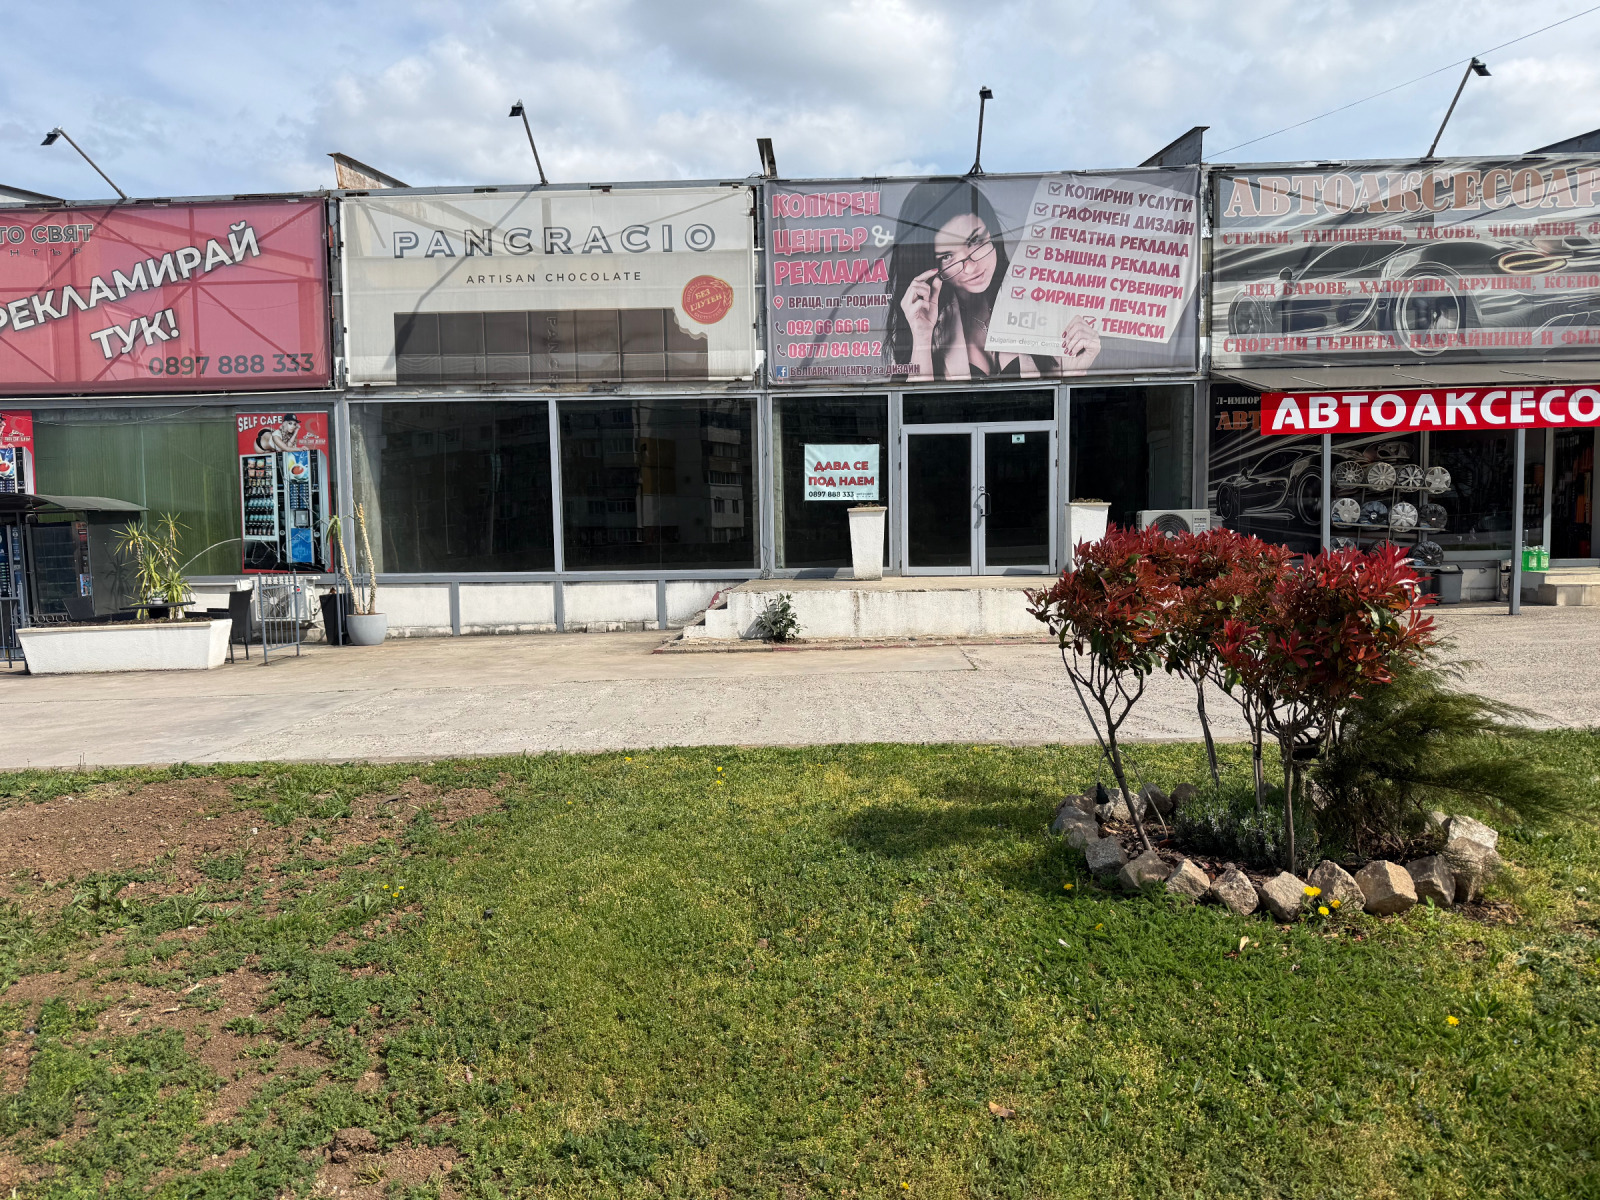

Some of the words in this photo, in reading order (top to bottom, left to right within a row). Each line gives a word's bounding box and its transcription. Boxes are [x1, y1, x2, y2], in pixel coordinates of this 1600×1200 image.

[1064, 183, 1134, 206] КОПИРНИ
[1137, 192, 1194, 213] УСЛУГИ
[1224, 167, 1600, 217] АВТОАКСЕСОАР
[772, 191, 880, 218] КОПИРЕН
[1051, 204, 1131, 228] ГРАФИЧЕН
[1133, 216, 1195, 236] ДИЗАЙН
[31, 224, 93, 244] СВЯТ
[393, 223, 716, 259] PANCRACIO
[773, 227, 868, 255] ЦЕНТЪР
[871, 225, 894, 248] &
[1050, 226, 1116, 248] ПЕЧАТНА
[1120, 236, 1189, 258] РЕКЛАМА
[1223, 230, 1293, 245] СТЕЛКИ,
[1301, 227, 1407, 243] ТАПИЦЕРИИ,
[1415, 225, 1480, 240] ТАСОВЕ,
[1488, 222, 1581, 237] ЧИСТАЧКИ,
[774, 258, 889, 286] РЕКЛАМА
[1043, 246, 1107, 269] ВЪНШНА
[1110, 255, 1180, 278] РЕКЛАМА
[466, 273, 536, 284] ARTISAN
[545, 271, 642, 283] CHOCOLATE
[1029, 266, 1107, 289] РЕКЛАМНИ
[1109, 278, 1183, 300] СУВЕНИРИ
[1243, 283, 1276, 298] ЛЕД
[1283, 281, 1351, 296] БАРОВЕ,
[1360, 279, 1451, 293] ХАЛОГЕНИ,
[1458, 276, 1536, 291] КРУШКИ,
[690, 293, 722, 312] ГЛУТЕН
[695, 289, 710, 300] БЕЗ
[788, 296, 823, 310] ВРАЦА,
[841, 294, 892, 307] "РОДИНА"
[1030, 287, 1105, 310] ФИРМЕНИ
[1109, 298, 1167, 318] ПЕЧАТИ
[787, 320, 813, 335] 092
[815, 319, 833, 335] 66
[835, 319, 853, 334] 66
[855, 318, 870, 334] 16
[1007, 312, 1048, 328] bdc
[1101, 317, 1165, 339] ТЕНИСКИ
[90, 308, 180, 359] ТУК!
[1223, 336, 1308, 352] СПОРТНИ
[1409, 329, 1532, 348] НАКРАЙНИЦИ
[1541, 330, 1553, 345] И
[788, 343, 829, 358] 08777
[831, 342, 850, 357] 84
[852, 341, 870, 357] 84
[872, 341, 881, 357] 2
[149, 356, 209, 375] 0897
[218, 355, 265, 374] 888
[273, 352, 314, 372] 333
[790, 365, 839, 377] БЪЛГАРСКИ
[839, 365, 871, 377] ЦЕНТЪР
[873, 367, 884, 375] за
[886, 363, 920, 375] ДИЗАЙН
[1271, 388, 1600, 430] АВТОАКСЕСО
[237, 416, 258, 432] SELF
[260, 415, 283, 425] CAFE
[814, 461, 850, 472] ДАВА
[853, 461, 869, 470] СЕ
[808, 476, 836, 487] ПОД
[839, 476, 874, 486] НАЕМ
